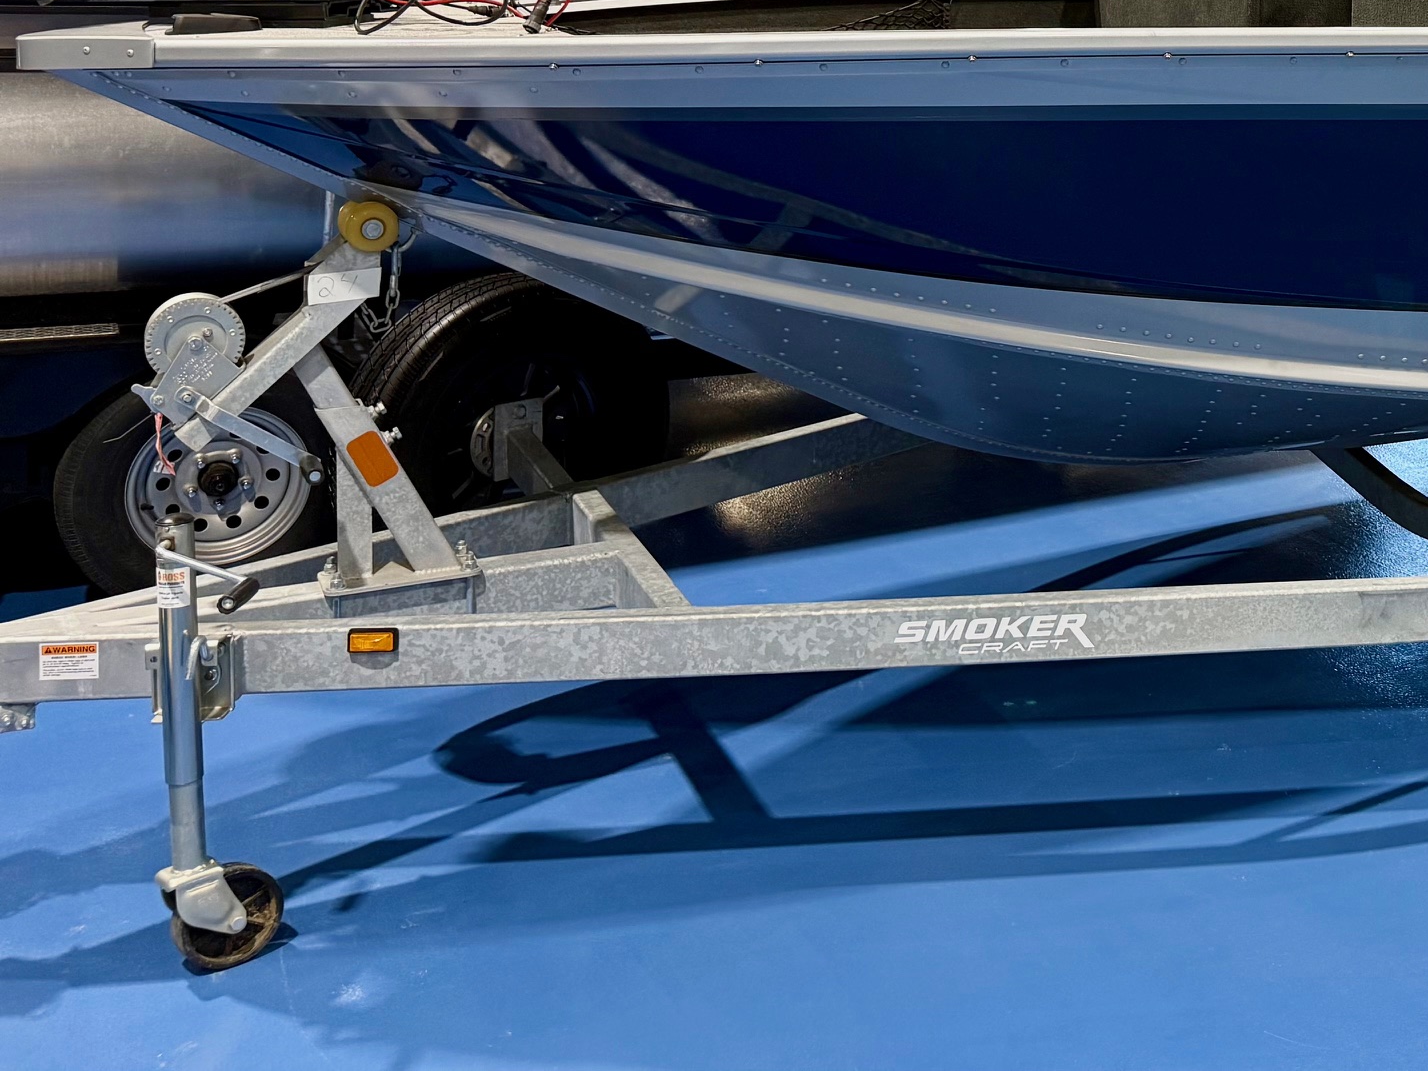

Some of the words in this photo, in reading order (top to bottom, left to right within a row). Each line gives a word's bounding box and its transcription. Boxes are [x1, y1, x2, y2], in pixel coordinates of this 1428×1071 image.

[893, 613, 1095, 648] SMOKER
[53, 645, 96, 654] WARNING
[957, 638, 1070, 656] CRAFT
